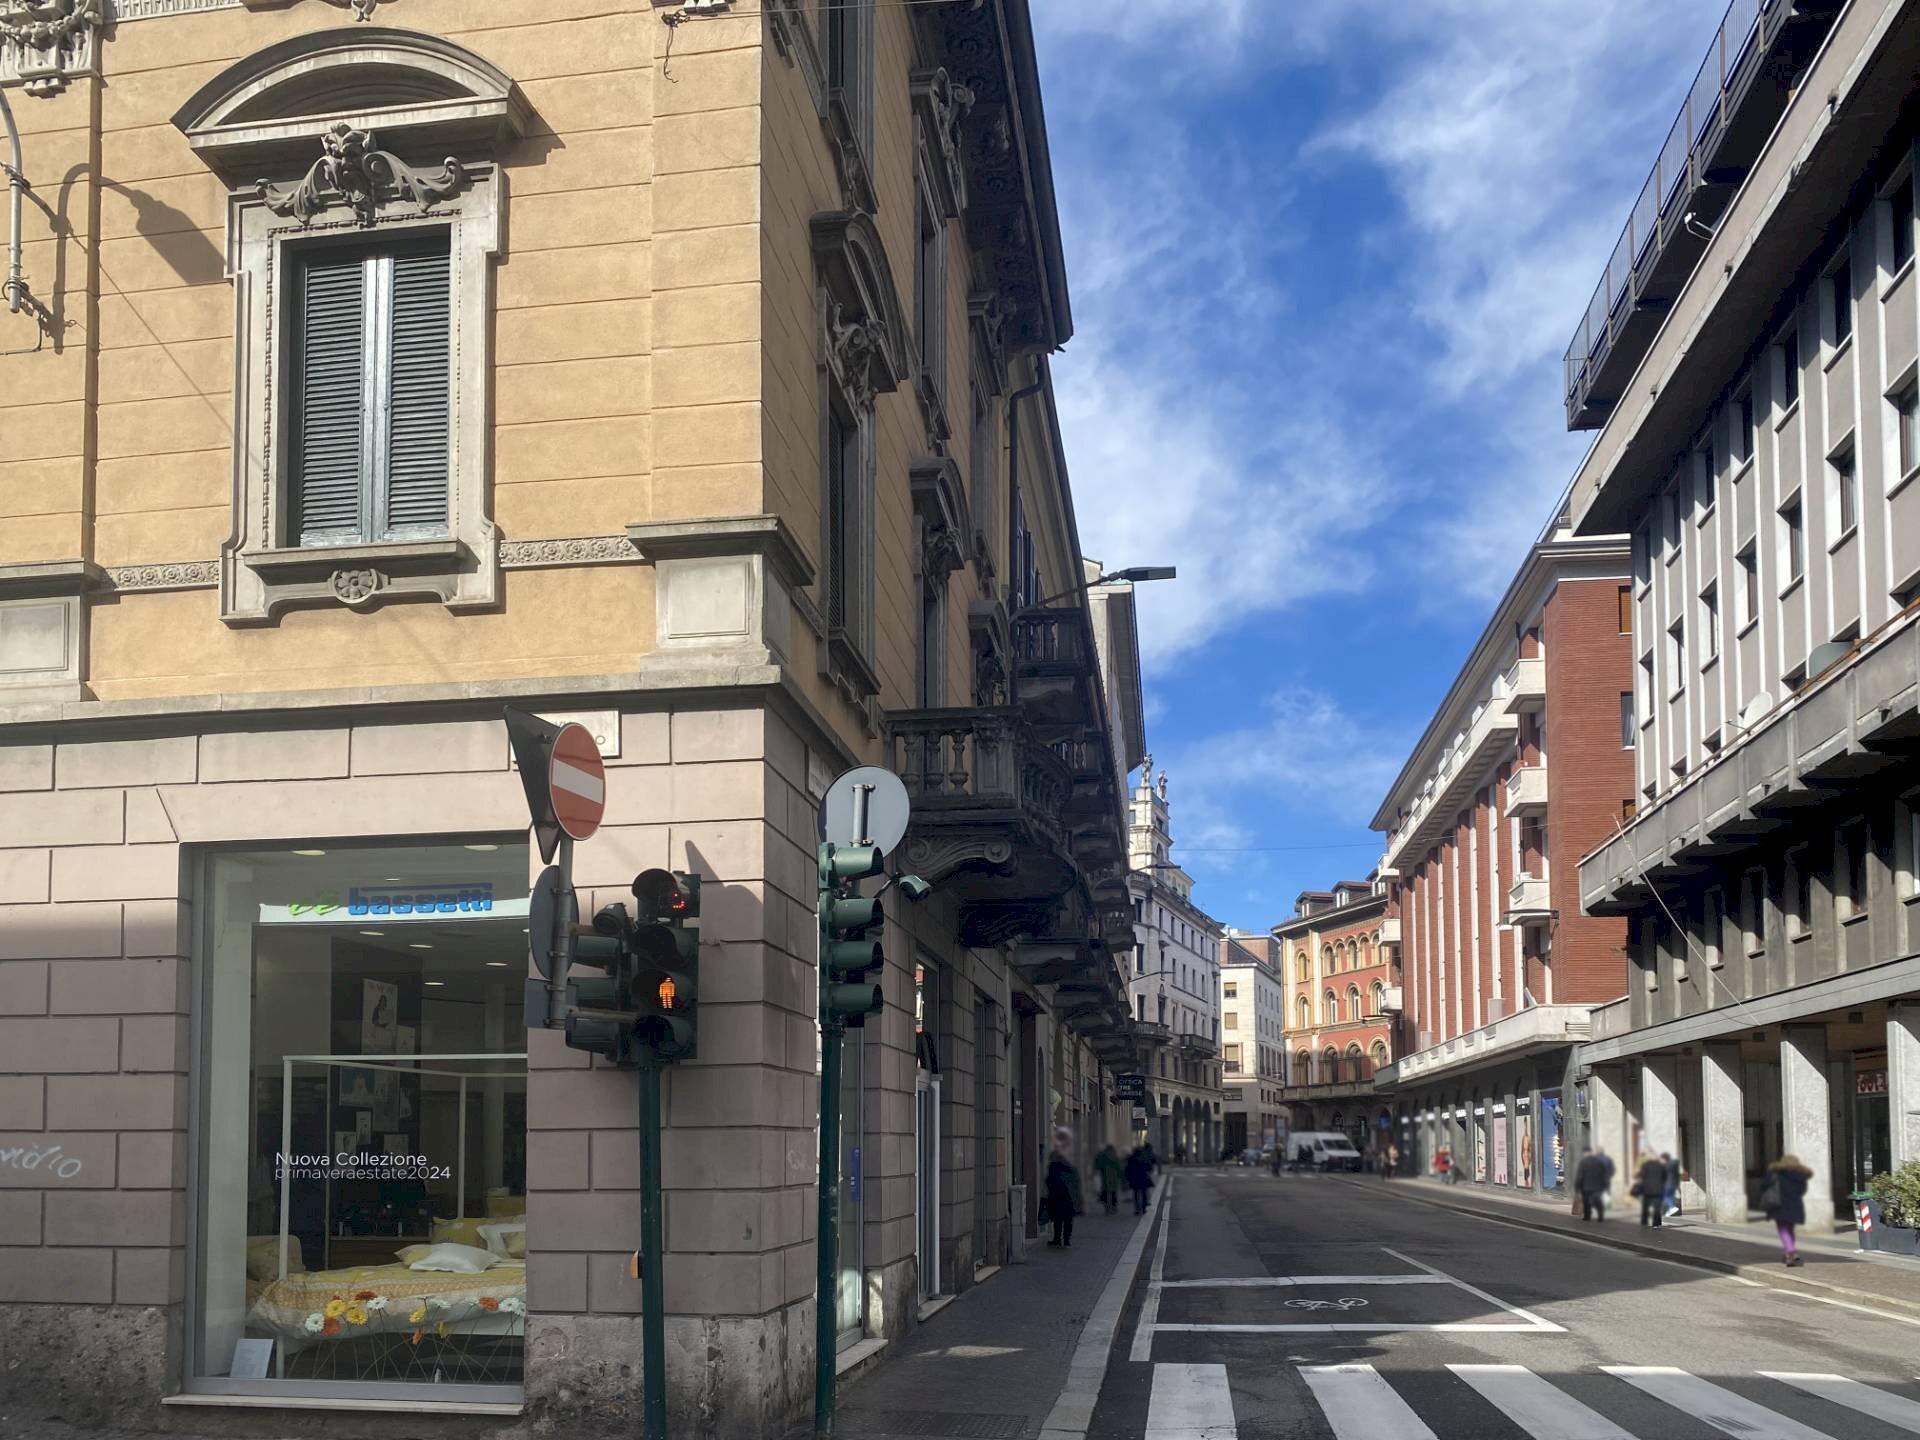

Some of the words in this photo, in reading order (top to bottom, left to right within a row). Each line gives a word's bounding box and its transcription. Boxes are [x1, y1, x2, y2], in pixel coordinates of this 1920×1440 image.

[348, 883, 493, 915] bassetti
[275, 1152, 330, 1166] Nuova
[336, 1152, 427, 1166] Collezione
[275, 1166, 451, 1181] primaveraestate2024
